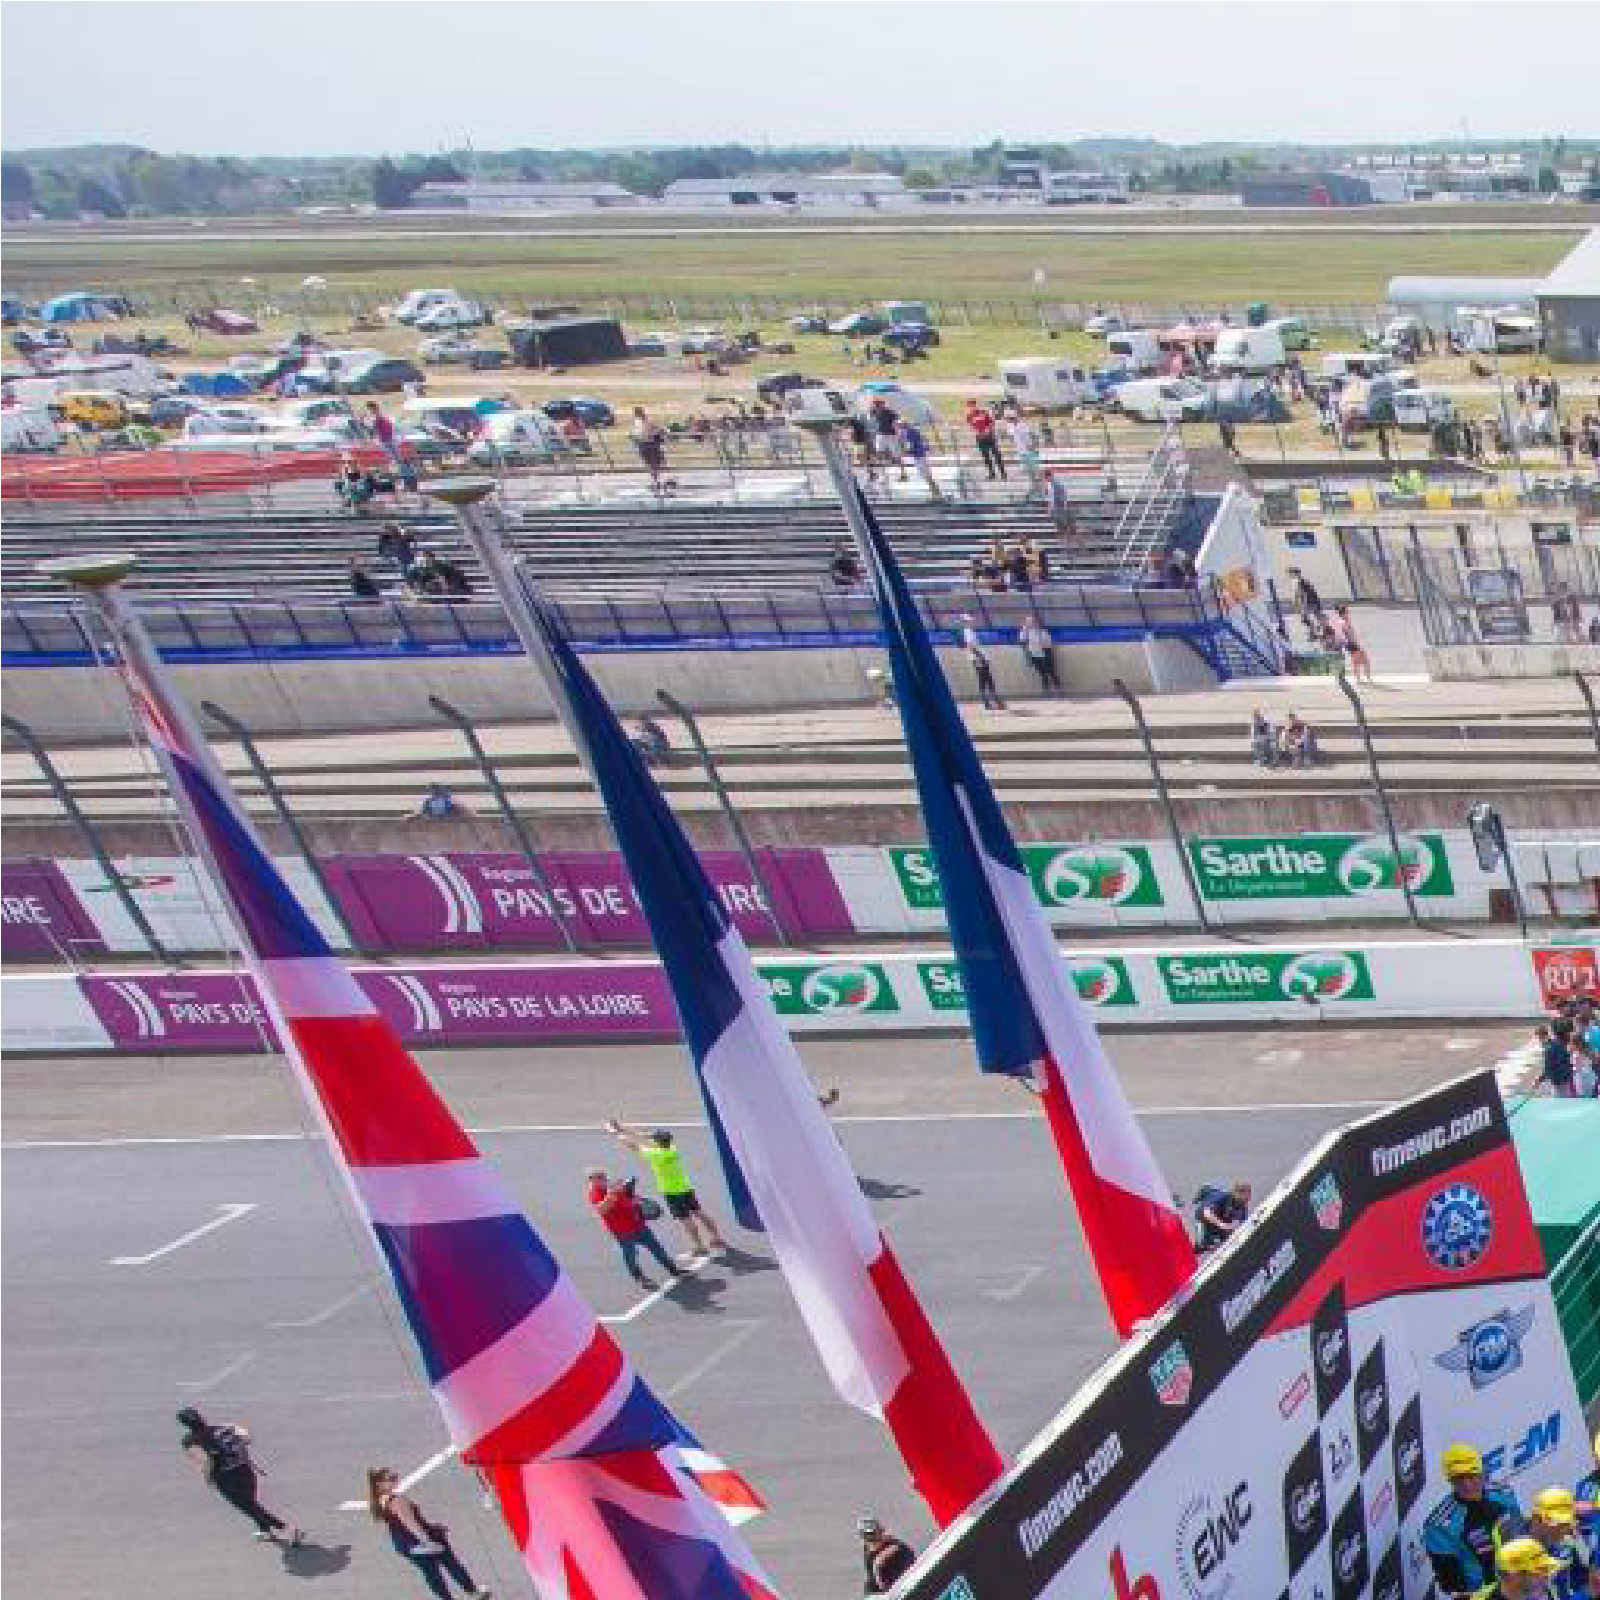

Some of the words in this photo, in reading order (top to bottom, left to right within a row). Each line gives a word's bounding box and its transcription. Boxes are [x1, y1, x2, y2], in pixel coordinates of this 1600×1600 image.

[1200, 843, 1327, 878] Sarthe
[581, 887, 628, 916] DE
[1168, 955, 1270, 986] Sarthe
[169, 1003, 231, 1025] PAYS
[449, 998, 502, 1018] PAYS
[509, 997, 541, 1018] DE
[546, 996, 577, 1016] LA
[585, 994, 650, 1016] LOIRE
[1192, 1479, 1252, 1580] EWC
